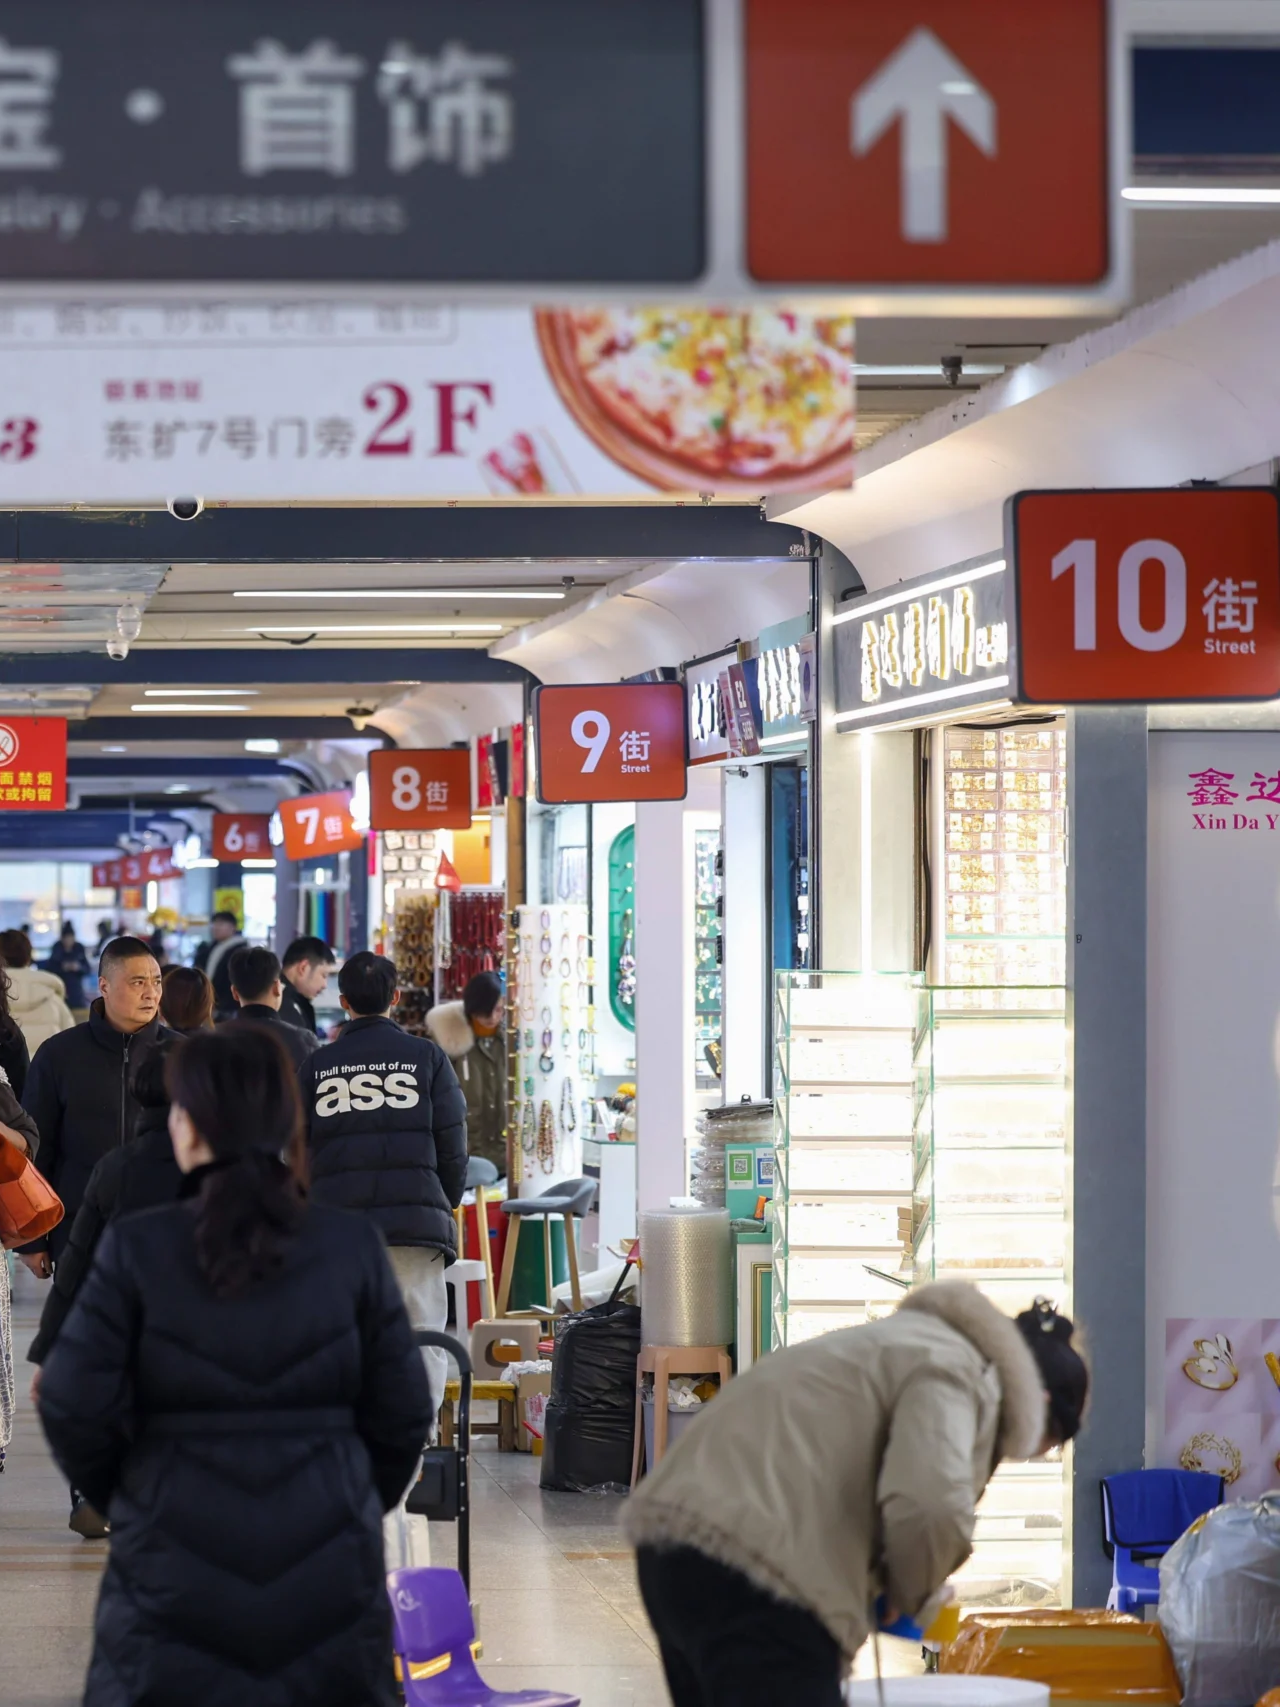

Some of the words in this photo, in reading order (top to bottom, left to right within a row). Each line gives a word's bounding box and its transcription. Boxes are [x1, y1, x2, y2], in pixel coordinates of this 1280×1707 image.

[132, 188, 405, 236] Accessories
[361, 379, 495, 458] 2F
[1204, 639, 1256, 655] Street
[621, 764, 651, 774] Street
[1192, 814, 1226, 830] Xin
[1232, 813, 1259, 830] Da
[320, 1066, 338, 1079] pull
[341, 1064, 366, 1073] them
[368, 1063, 386, 1071] out
[388, 1061, 399, 1070] of
[401, 1063, 417, 1073] my
[315, 1073, 419, 1117] ass
